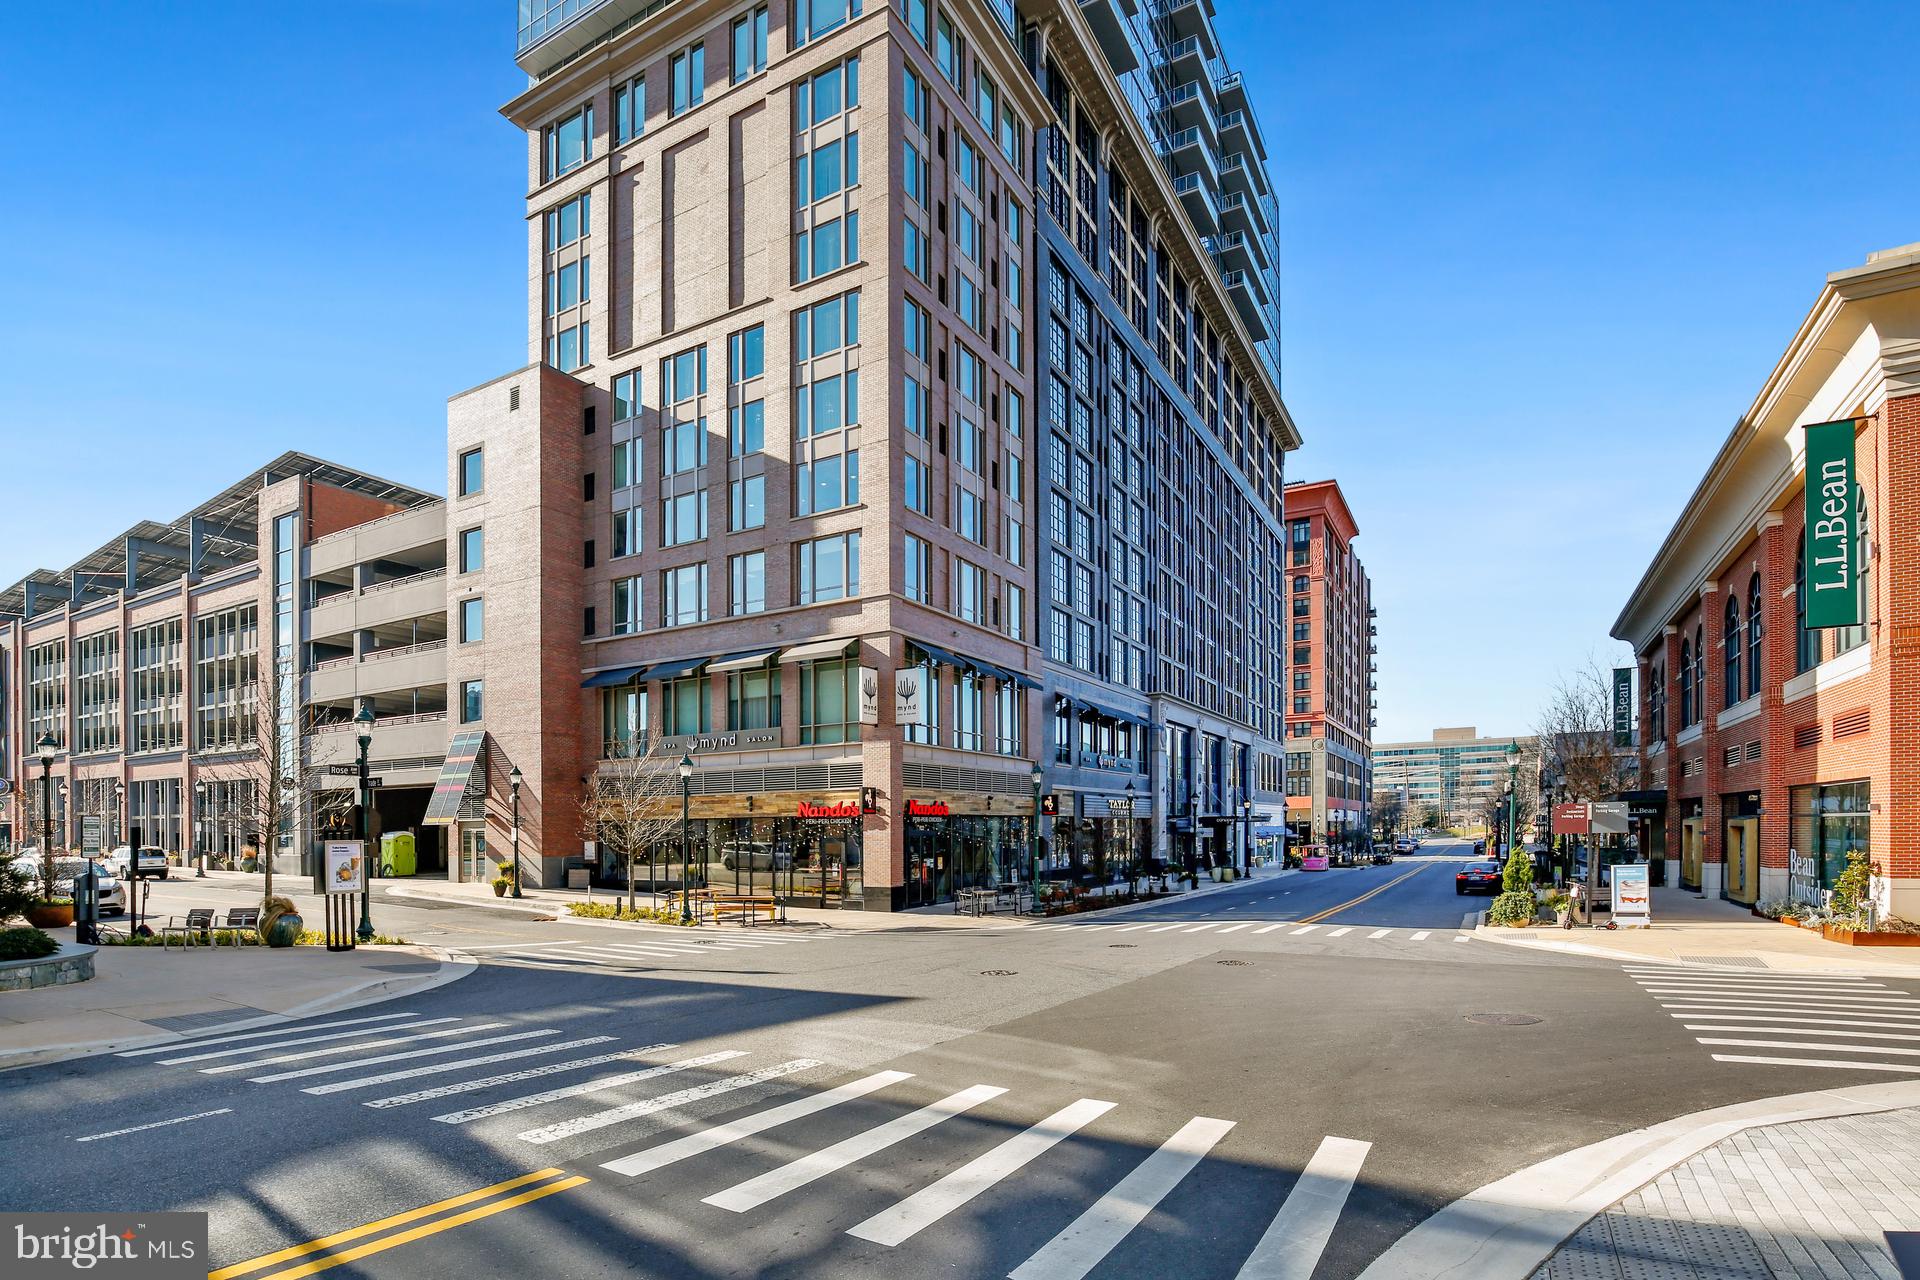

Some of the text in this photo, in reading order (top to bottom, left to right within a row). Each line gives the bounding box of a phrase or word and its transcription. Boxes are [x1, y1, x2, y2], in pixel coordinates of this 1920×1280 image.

[1815, 458, 1848, 592] L.L.Bean
[1616, 682, 1629, 733] L.L.Bean
[700, 733, 736, 750] mynd
[746, 735, 773, 743] SALON
[331, 766, 349, 775] Rose
[798, 801, 860, 818] Nando's
[909, 799, 949, 816] Nando's
[1108, 799, 1136, 810] TAYLOR
[830, 817, 852, 825] CHICKEN
[1790, 848, 1815, 877] Bean
[1790, 875, 1832, 910] Outsider
